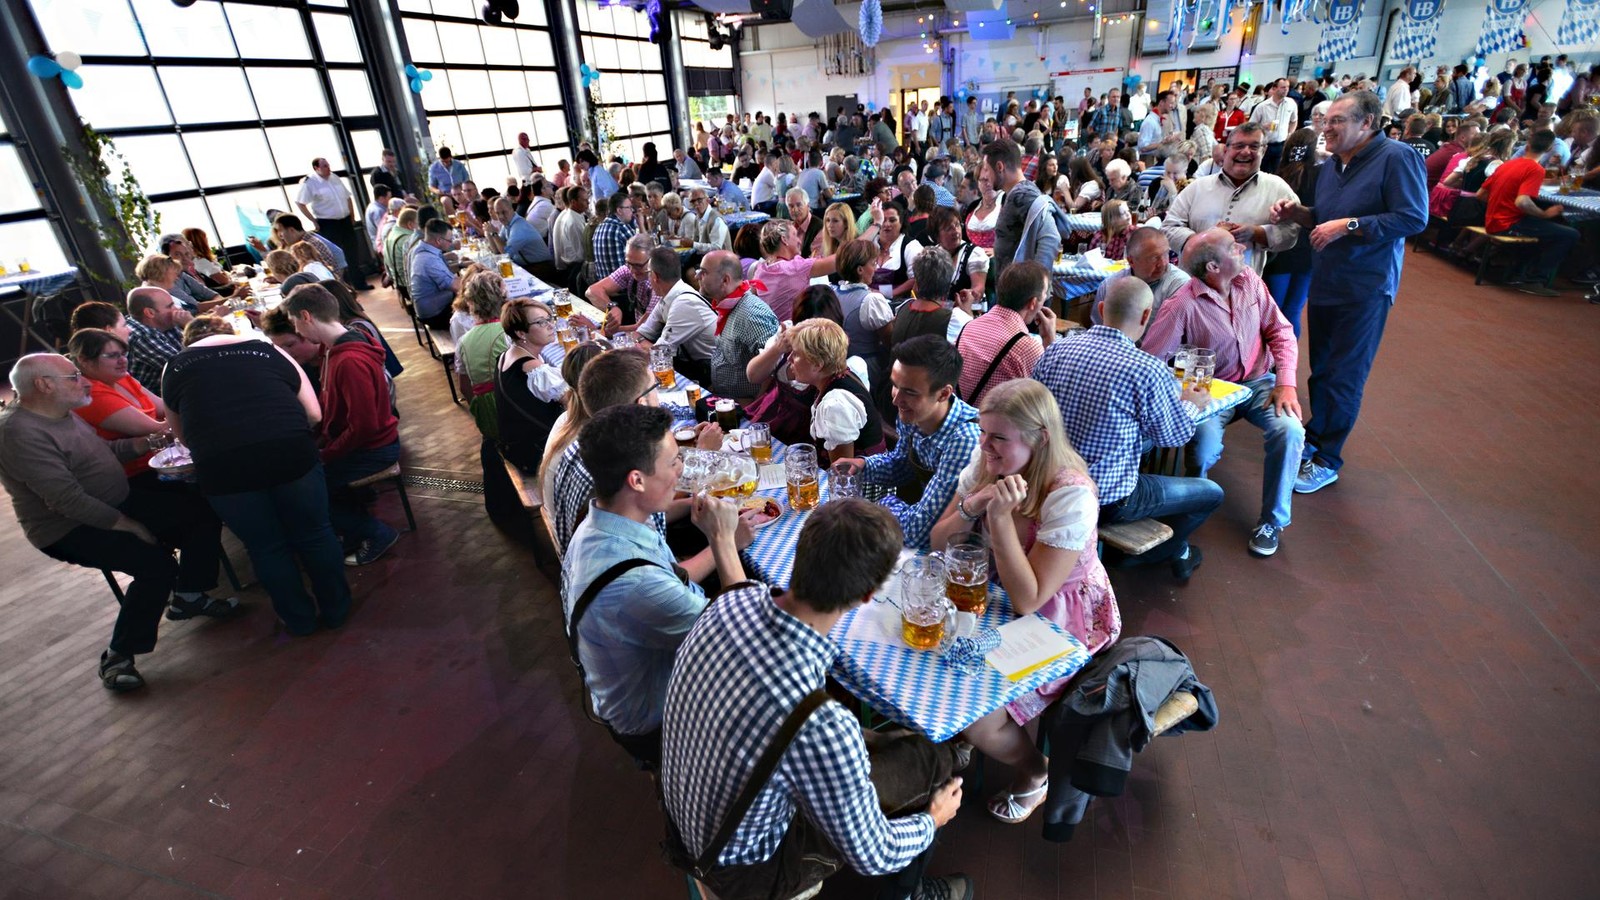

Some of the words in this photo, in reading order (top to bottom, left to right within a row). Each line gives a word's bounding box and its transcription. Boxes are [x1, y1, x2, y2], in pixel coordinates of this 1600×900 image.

[1334, 5, 1353, 20] HB
[1413, 1, 1434, 16] HB
[218, 350, 270, 359] Dancers
